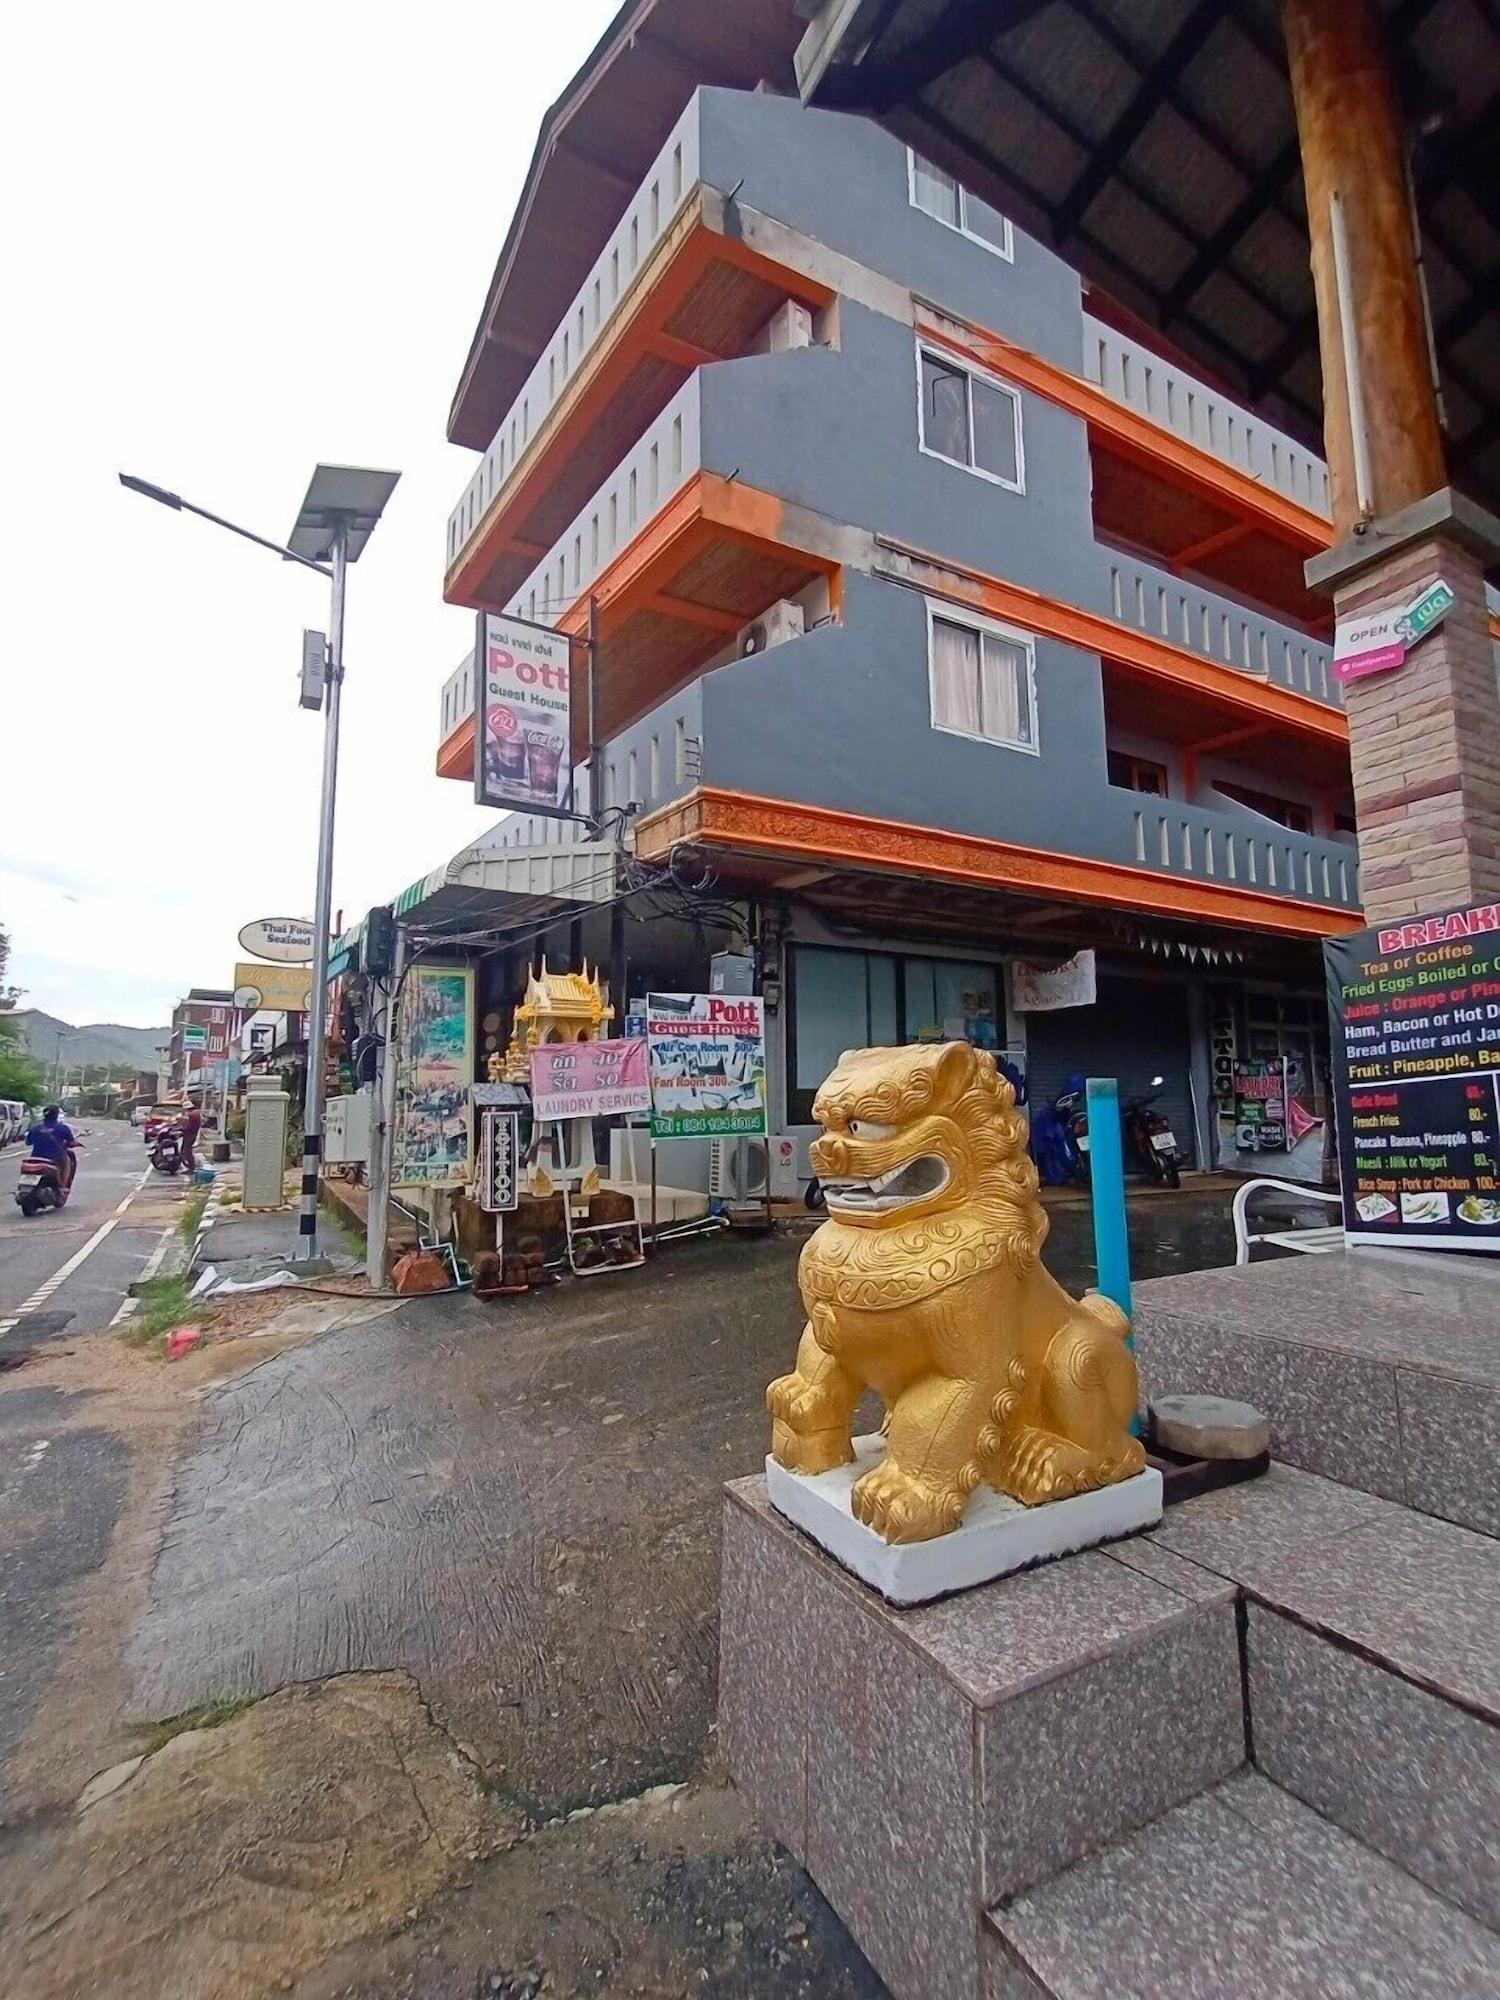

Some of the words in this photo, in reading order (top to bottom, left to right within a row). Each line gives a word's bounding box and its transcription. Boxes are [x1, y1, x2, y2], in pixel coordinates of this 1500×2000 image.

[1350, 625, 1388, 643] OPEN
[489, 646, 568, 692] Pott
[489, 682, 526, 702] Guest
[531, 692, 568, 712] House
[262, 923, 287, 934] Thai
[267, 934, 311, 945] Seafood
[1360, 962, 1389, 976] Tea
[1394, 957, 1411, 970] or
[1415, 944, 1473, 965] Coffee
[1341, 982, 1375, 999] Fried
[1380, 976, 1414, 993] Eggs
[1418, 963, 1467, 985] Boiled
[1471, 961, 1489, 975] or
[708, 999, 760, 1023] Pott
[1343, 1003, 1380, 1020] Juice
[1391, 991, 1446, 1011] Orange
[1450, 988, 1467, 1001] or
[654, 1022, 705, 1035] Guest
[710, 1023, 758, 1035] House
[1344, 1025, 1380, 1040] Ham,
[1383, 1017, 1429, 1034] Bacon
[1433, 1013, 1450, 1026] or
[1453, 1007, 1483, 1024] Hot
[661, 1041, 674, 1052] Air
[677, 1042, 698, 1052] Con
[701, 1041, 729, 1052] Room
[1346, 1042, 1387, 1059] Bread
[1390, 1036, 1437, 1054] Butter
[1441, 1029, 1471, 1047] and
[1349, 1063, 1381, 1079] Fruit
[1393, 1054, 1475, 1074] Pineapple,
[654, 1077, 673, 1088] Fan
[677, 1077, 706, 1088] Room
[537, 1097, 593, 1114] LAUNDRY
[599, 1093, 649, 1110] SERVICE
[1353, 1116, 1379, 1128] French
[1380, 1114, 1400, 1127] Fries
[494, 1117, 512, 1203] TATTOO
[781, 1158, 791, 1167] LG
[1390, 1155, 1408, 1168] Milk
[1409, 1157, 1418, 1168] or
[1419, 1155, 1447, 1170] Yogurt
[1358, 1178, 1375, 1191] Rice
[1376, 1178, 1397, 1192] Soup
[1402, 1178, 1422, 1190] Pork
[1423, 1180, 1432, 1189] or
[1434, 1177, 1470, 1190] Chicken
